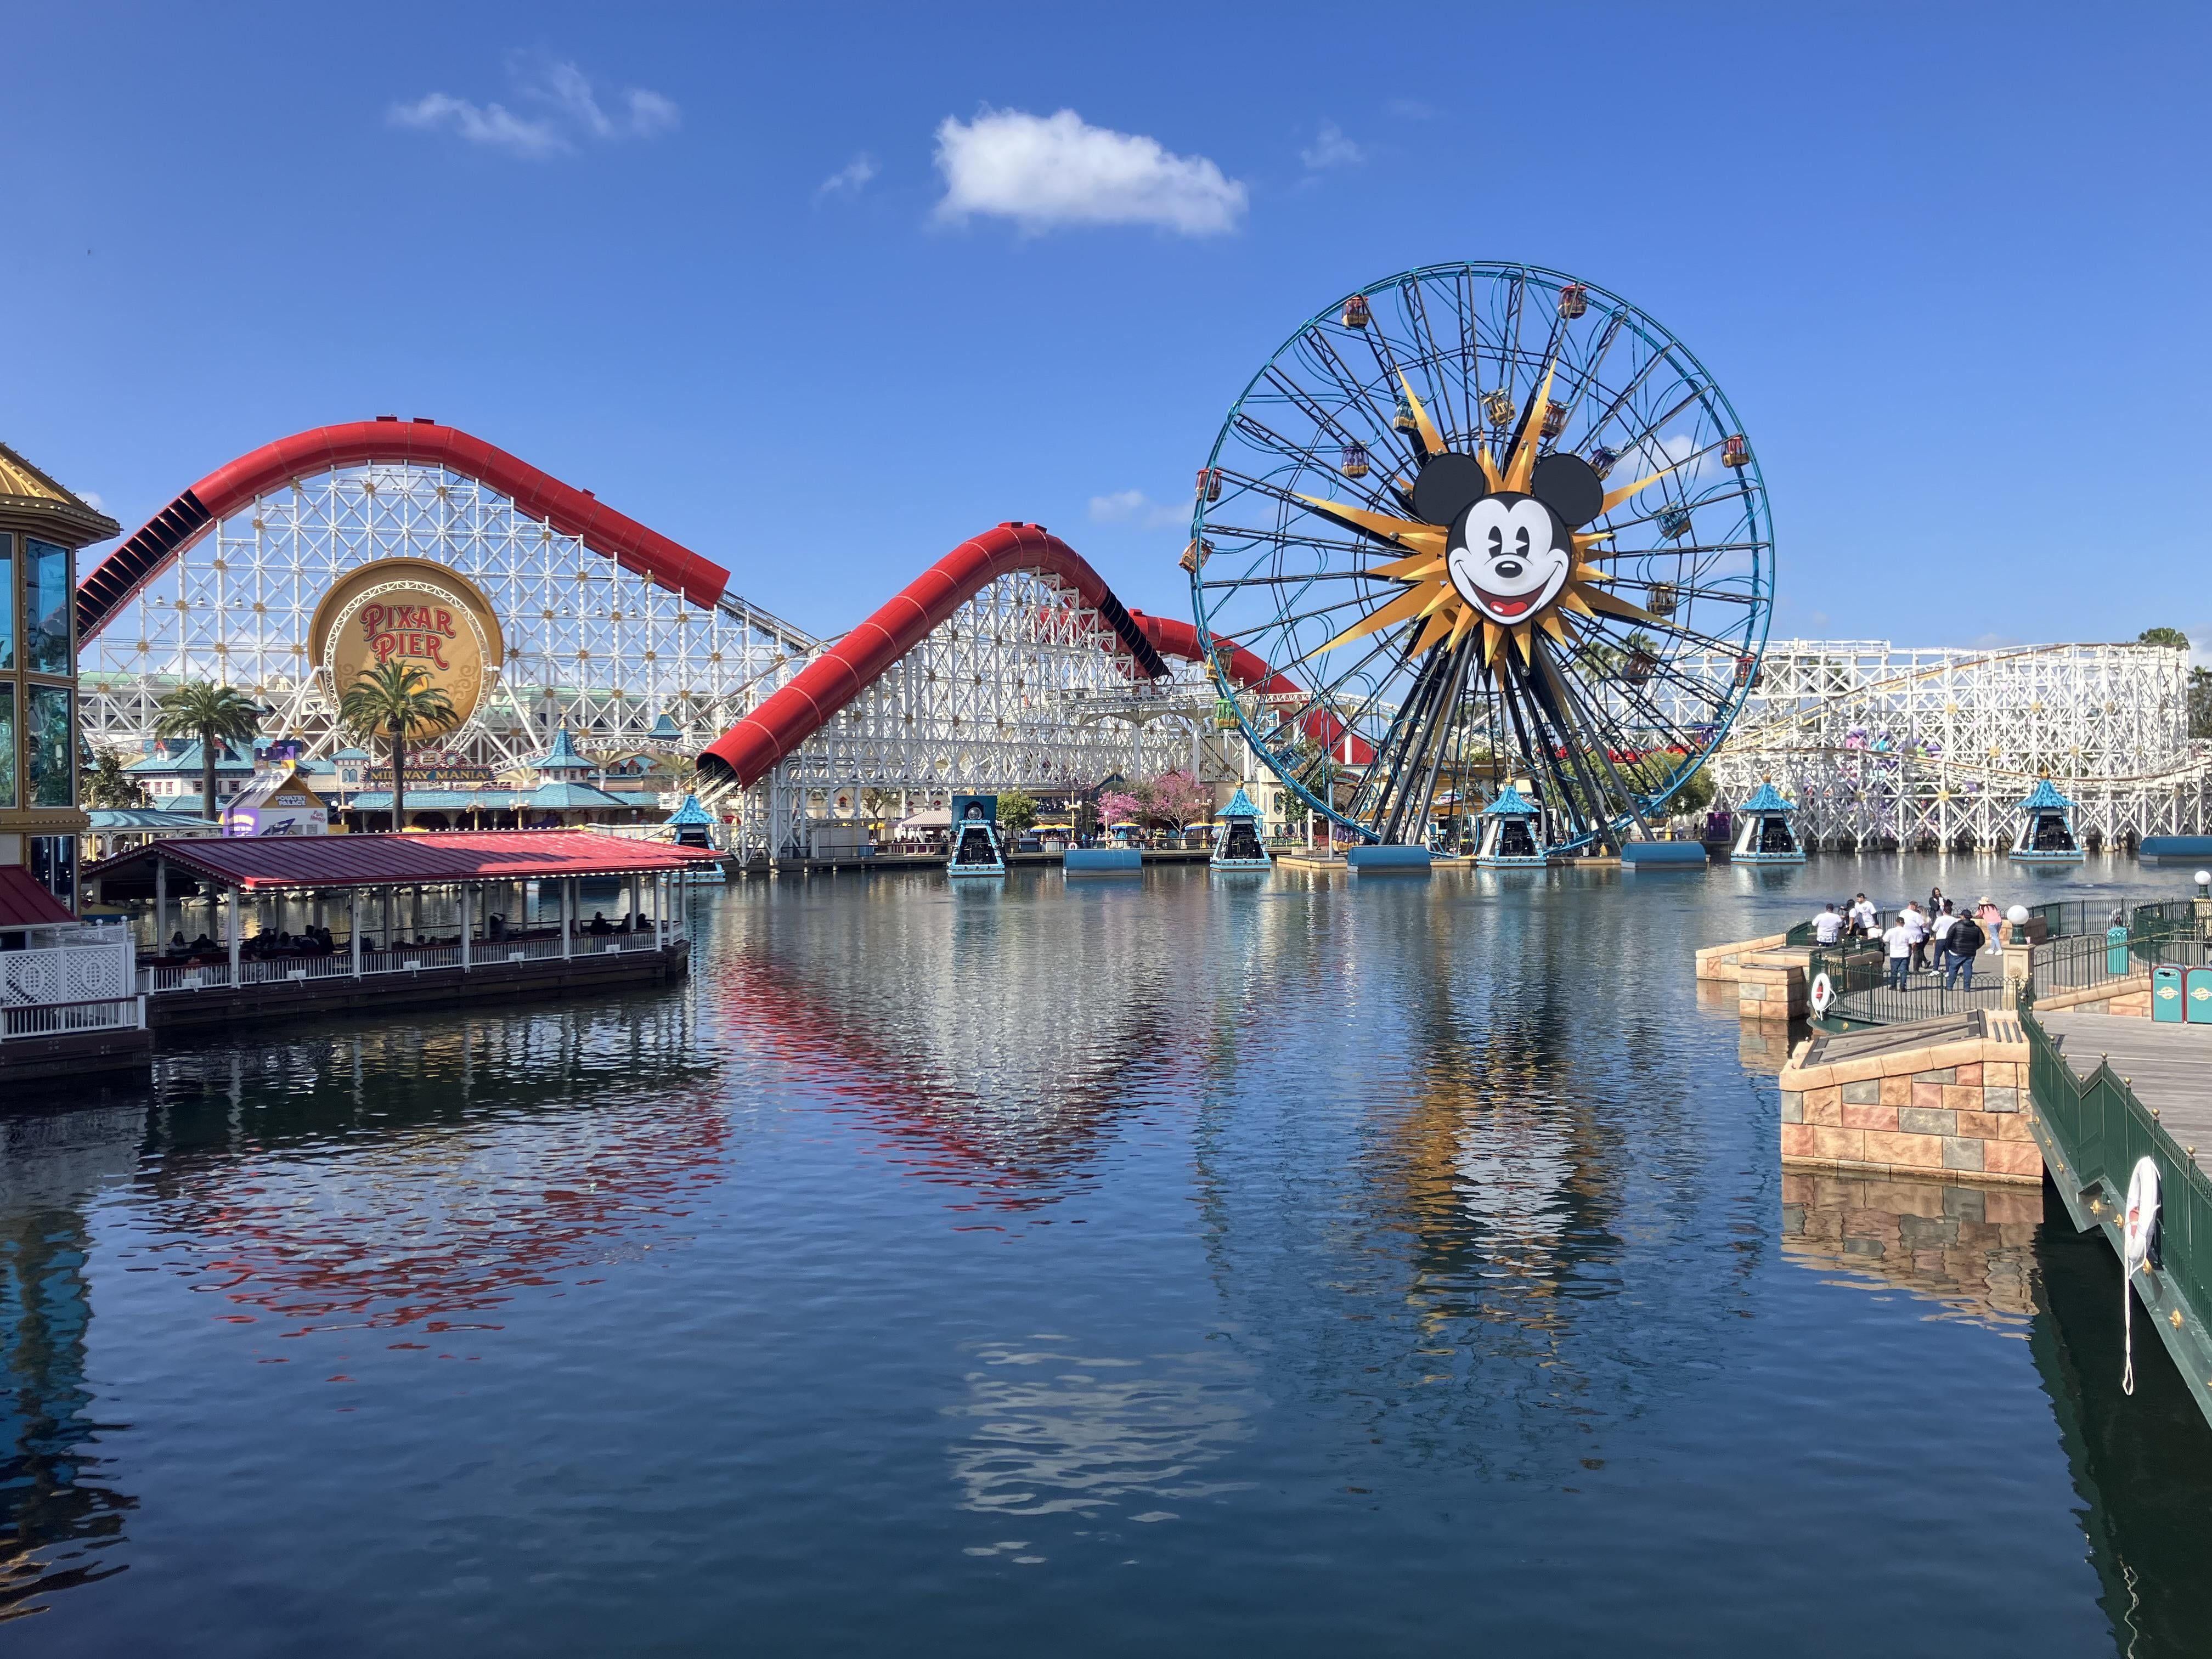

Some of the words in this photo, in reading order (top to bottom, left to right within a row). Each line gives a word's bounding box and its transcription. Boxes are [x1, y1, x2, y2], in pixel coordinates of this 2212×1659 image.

[360, 603, 455, 641] PIXAR
[370, 632, 449, 669] PIER
[436, 770, 489, 779] MANIA!
